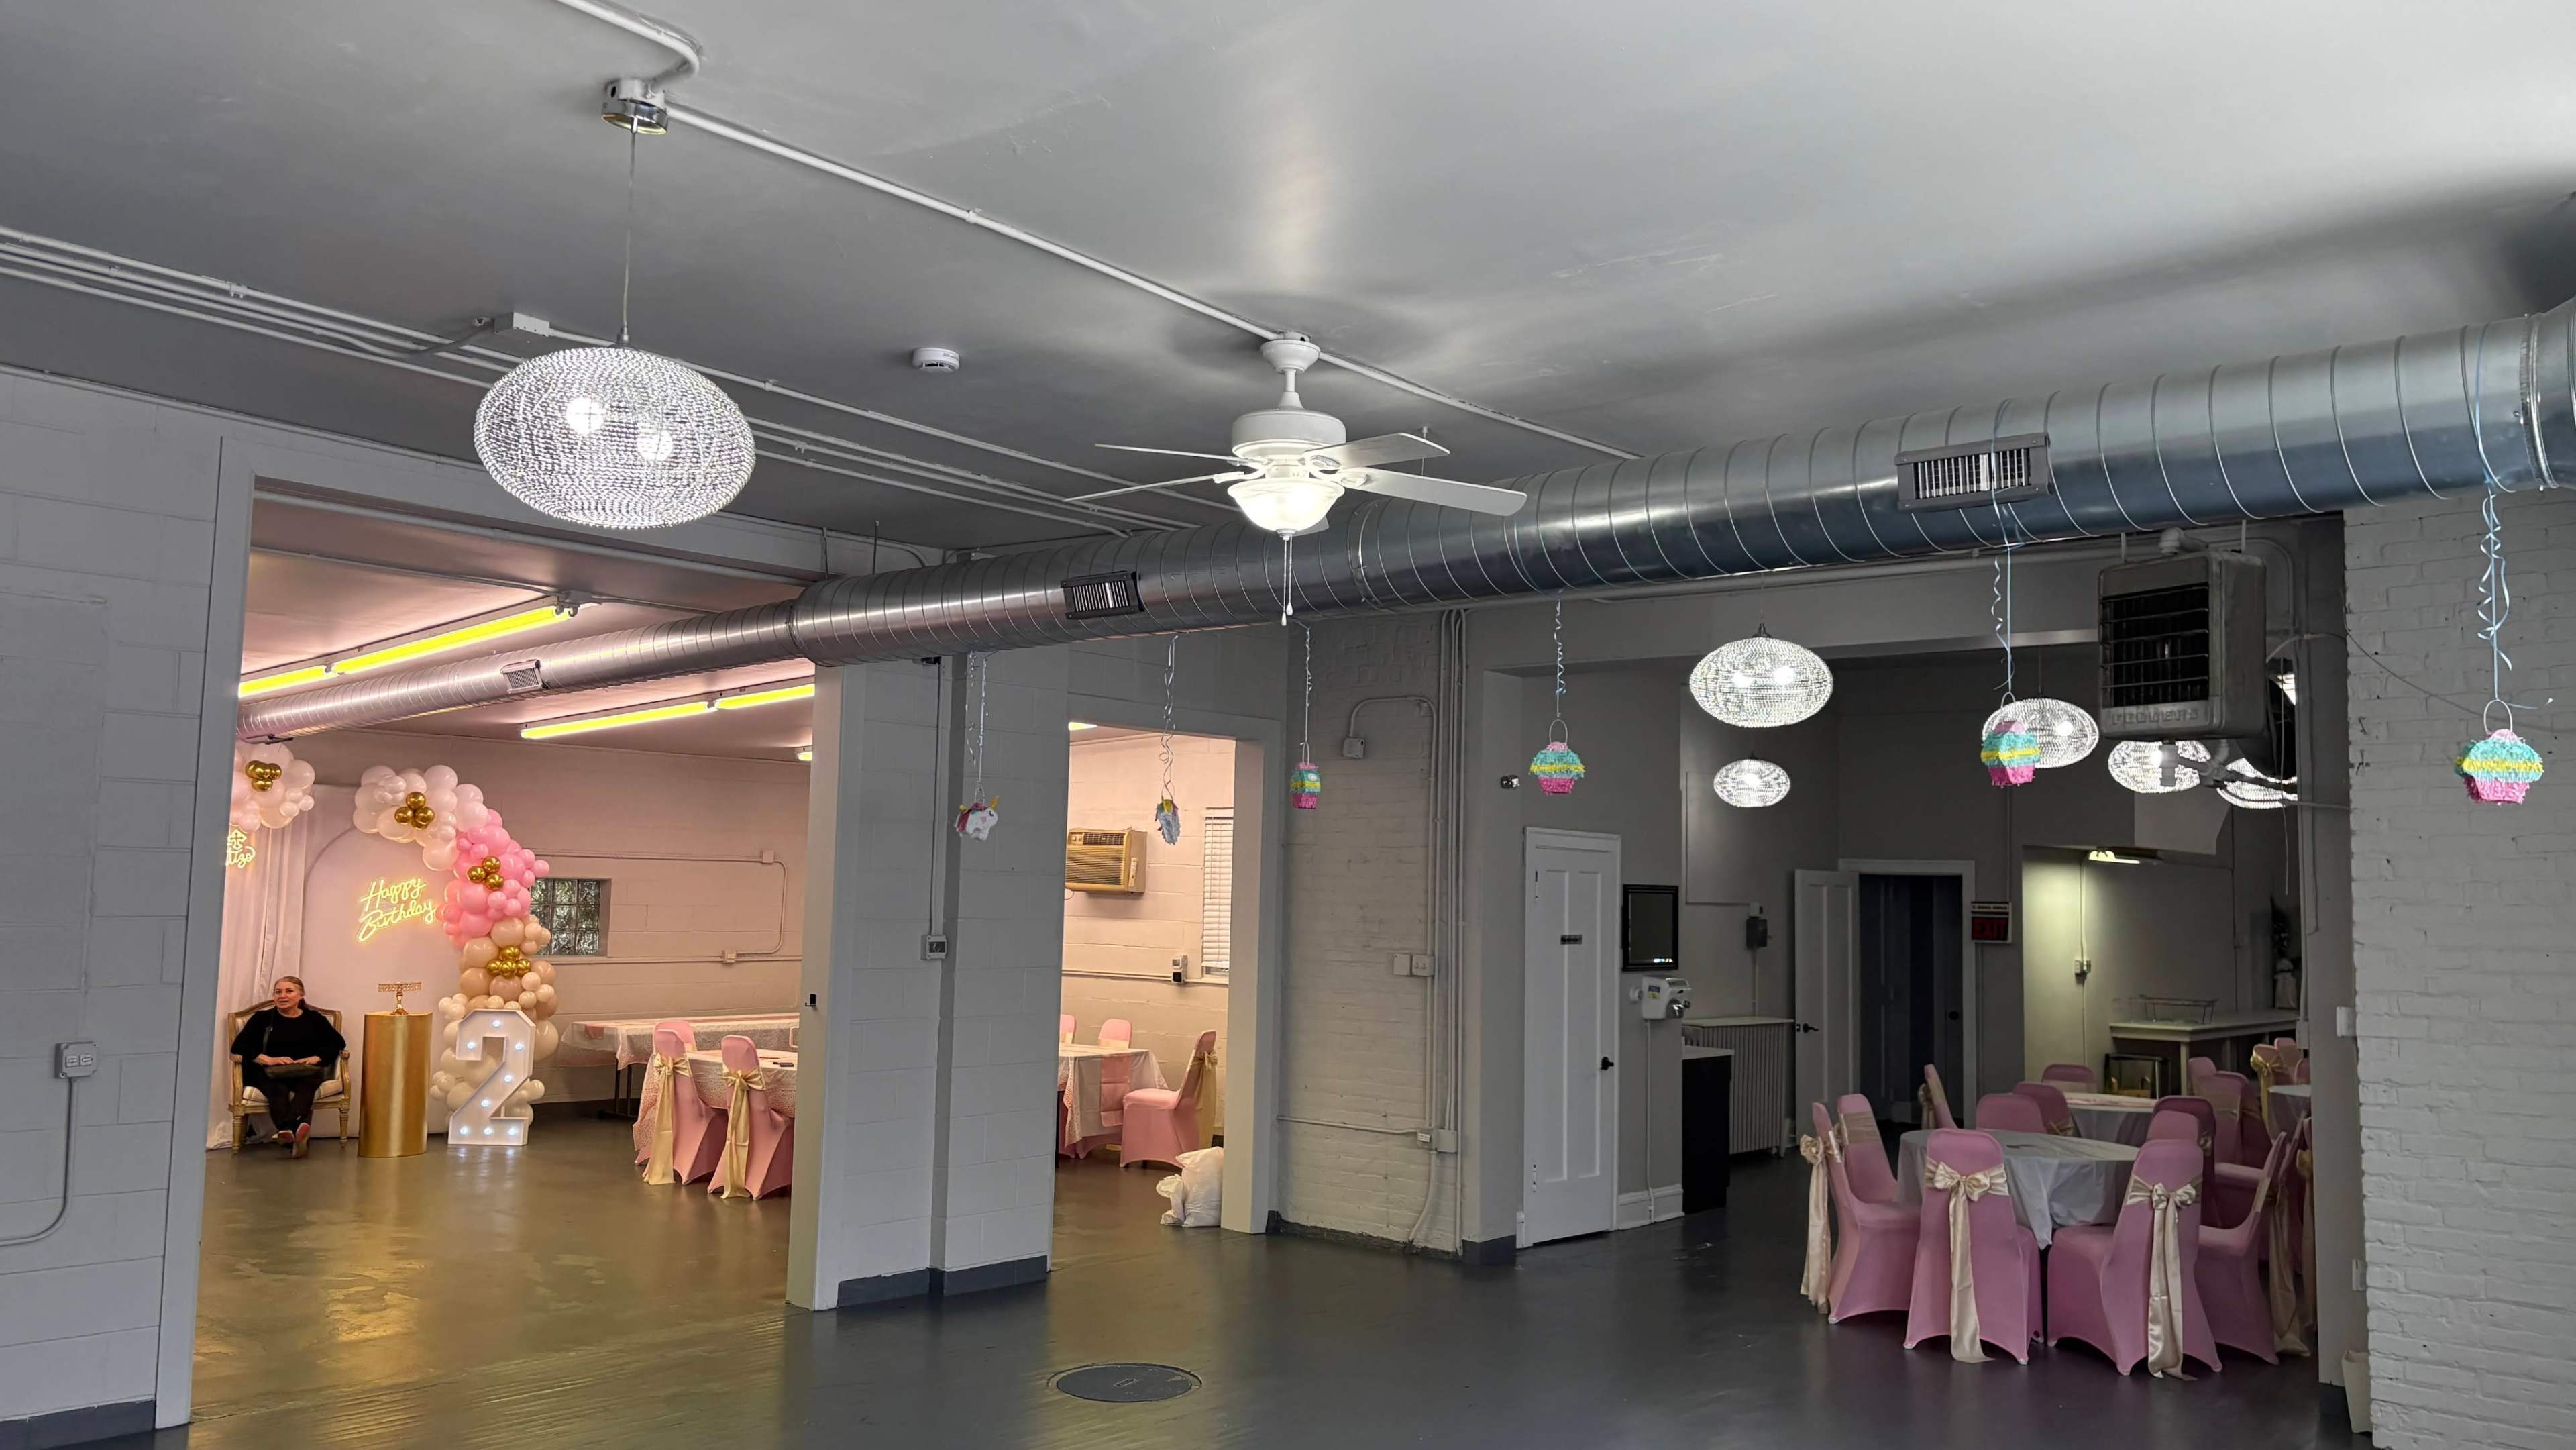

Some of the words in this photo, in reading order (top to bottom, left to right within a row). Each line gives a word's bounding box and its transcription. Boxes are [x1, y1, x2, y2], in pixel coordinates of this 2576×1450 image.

[360, 878, 427, 912] Happy
[358, 900, 436, 942] Birthday
[1974, 919, 2007, 938] EXIT
[448, 1008, 536, 1146] 2
